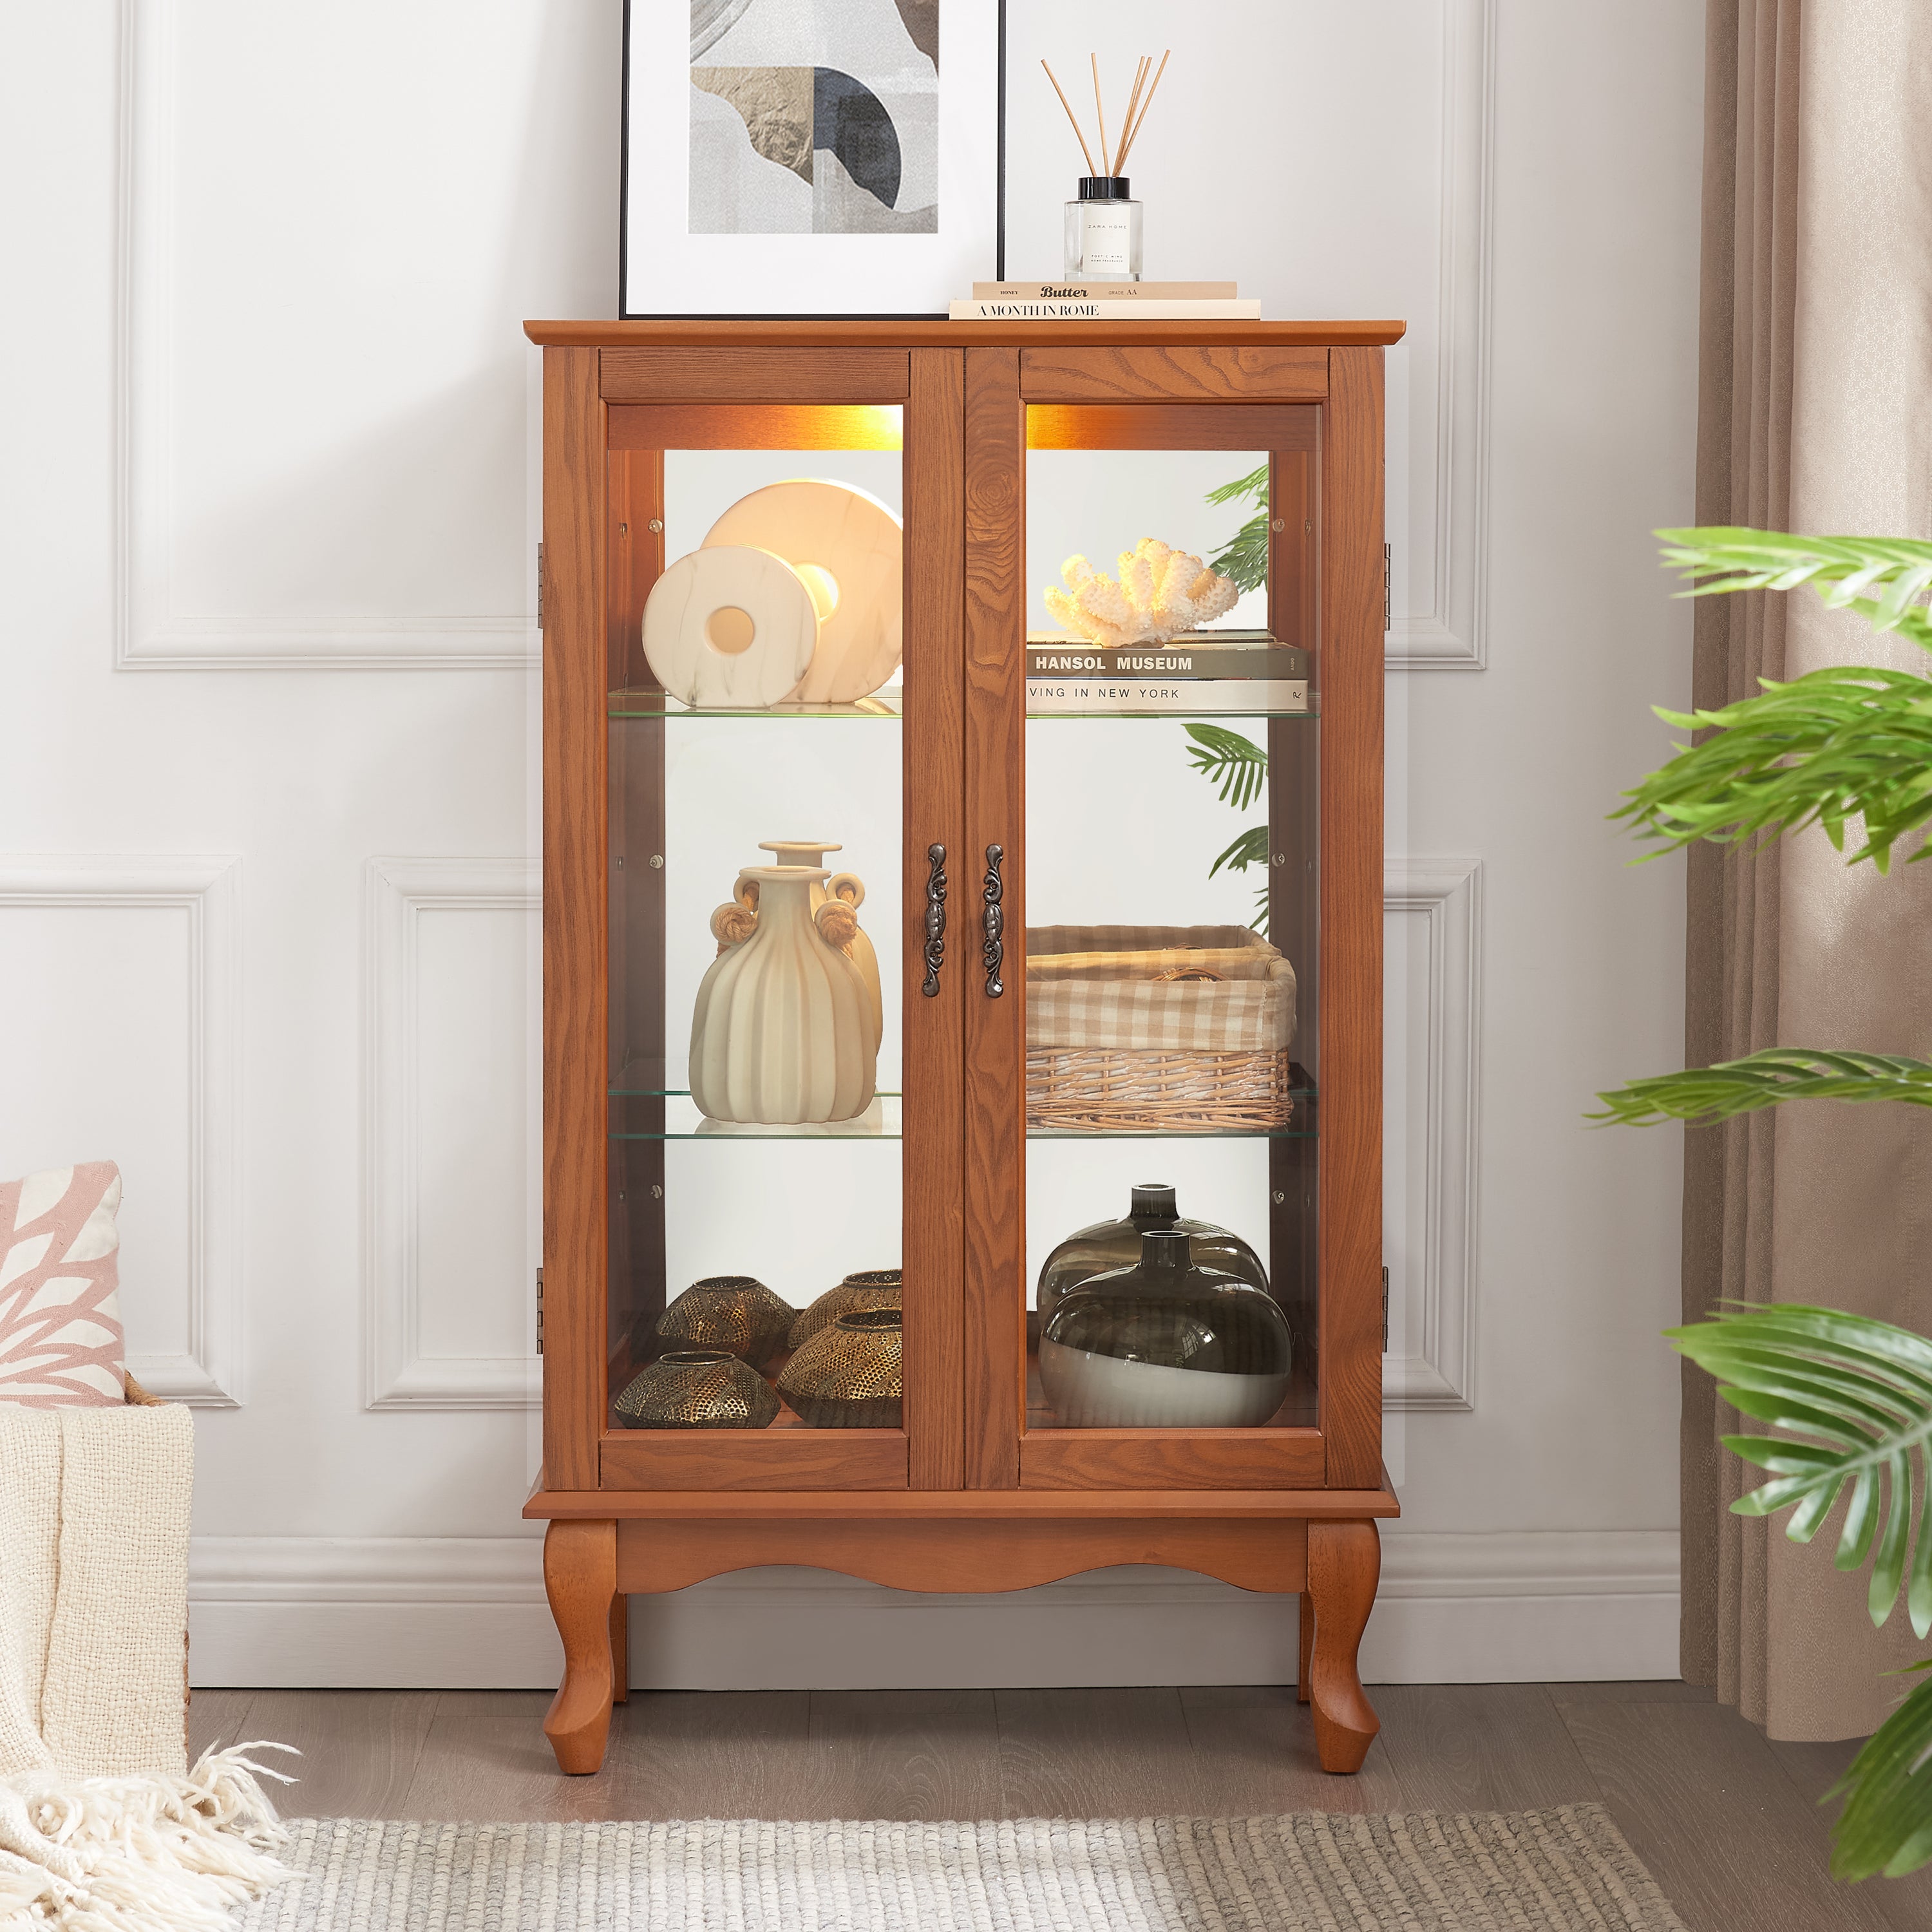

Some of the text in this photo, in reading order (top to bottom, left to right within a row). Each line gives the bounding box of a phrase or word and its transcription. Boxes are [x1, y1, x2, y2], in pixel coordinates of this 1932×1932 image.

[1040, 285, 1089, 298] Butter
[978, 305, 1099, 316] A MONTH IN ROME
[1036, 657, 1192, 670] HANSOL MUSEUM
[1075, 688, 1088, 697] IN
[1098, 688, 1130, 697] NEW
[1139, 689, 1179, 698] YORK
